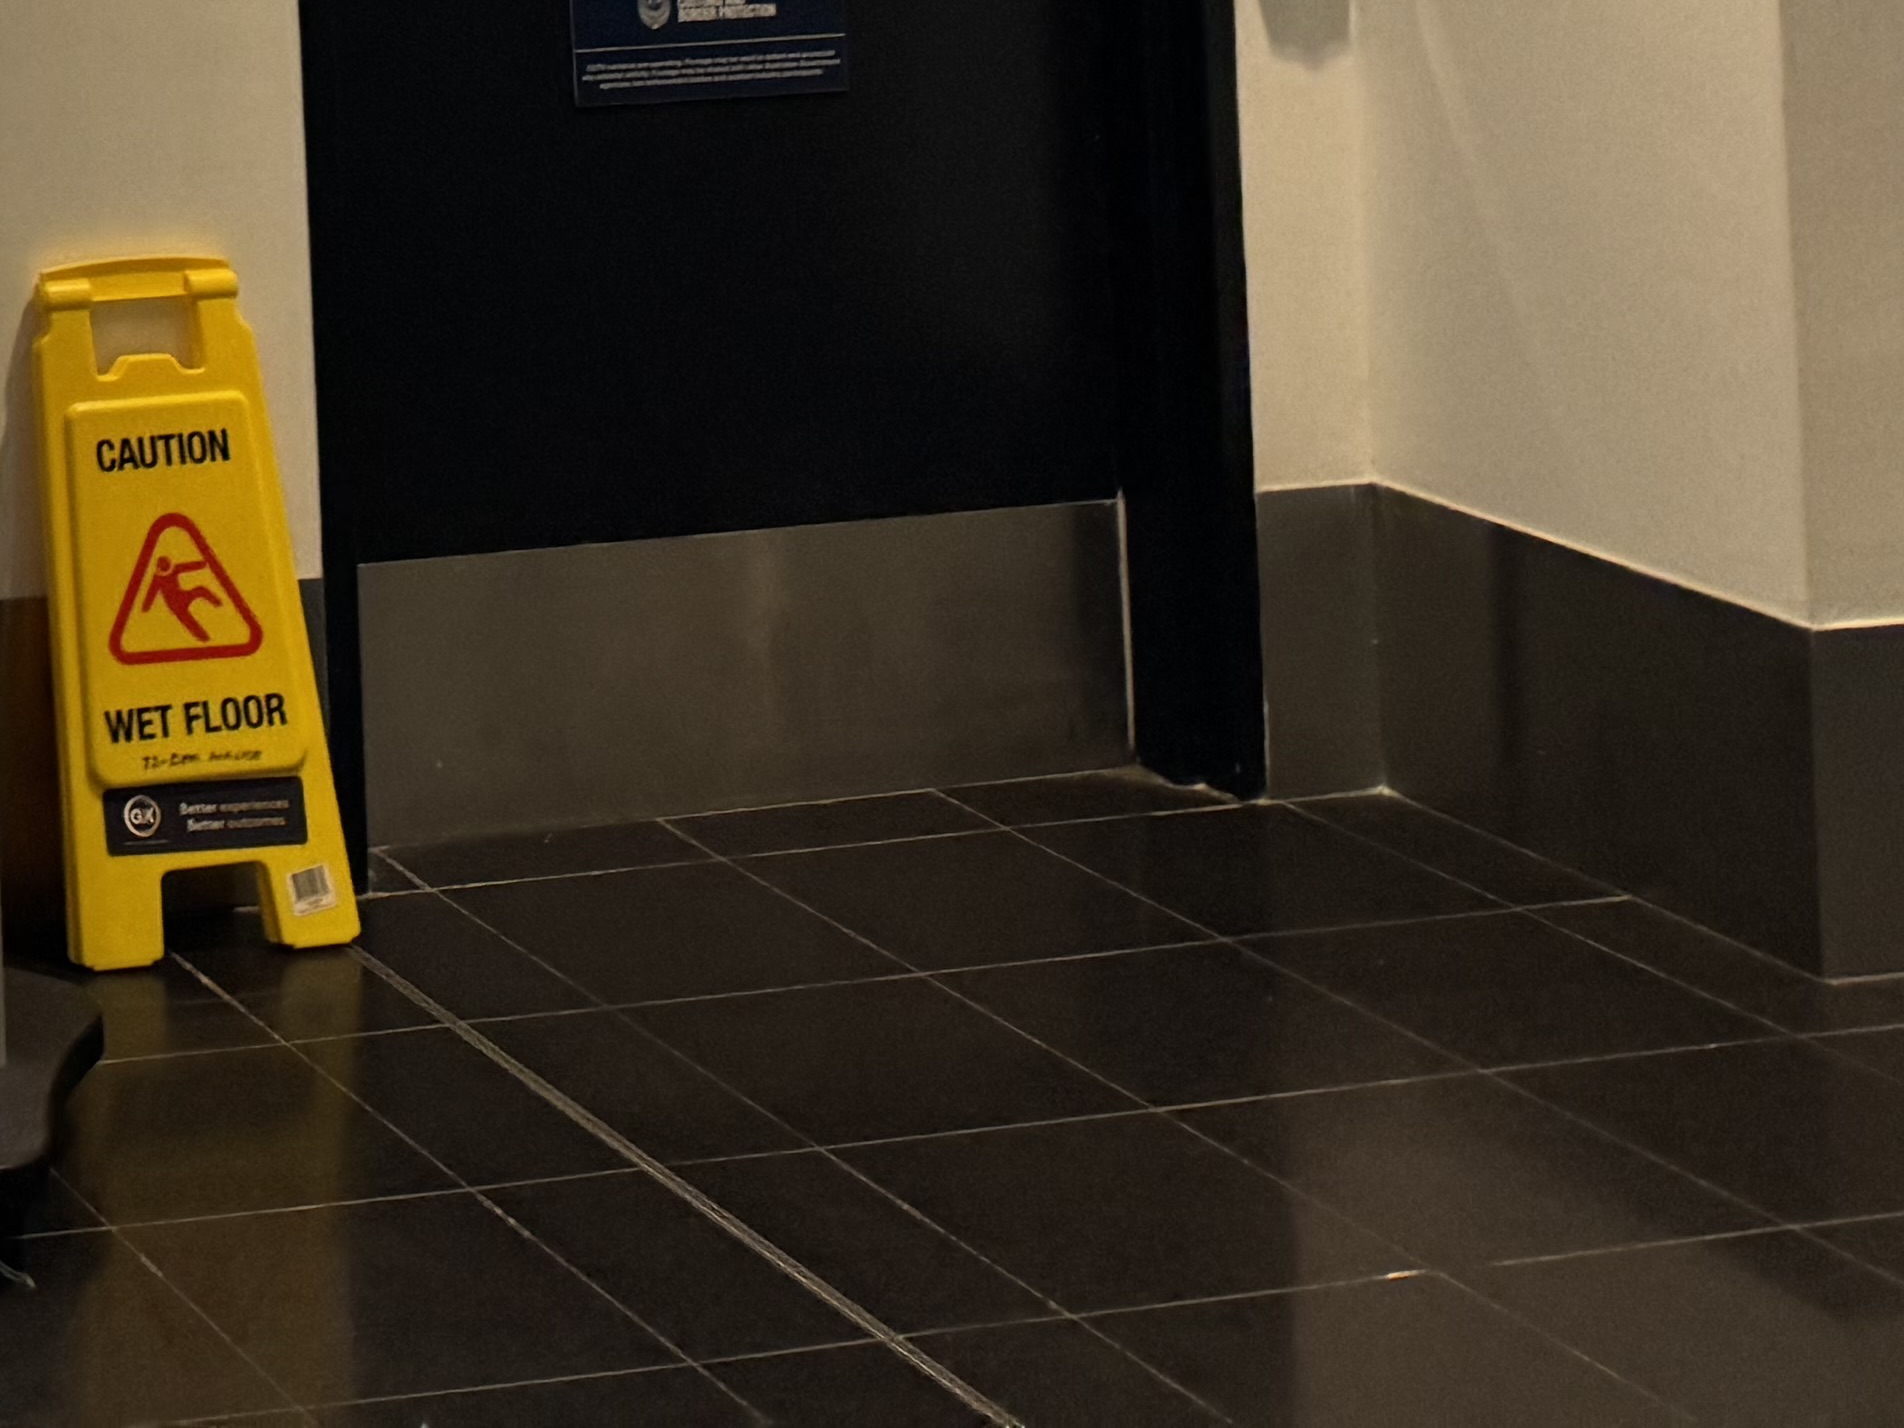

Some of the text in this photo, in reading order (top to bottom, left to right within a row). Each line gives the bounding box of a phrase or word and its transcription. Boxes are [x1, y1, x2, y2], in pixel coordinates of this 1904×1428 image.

[96, 429, 231, 472] CAUTION
[104, 694, 288, 744] WET FLOOR
